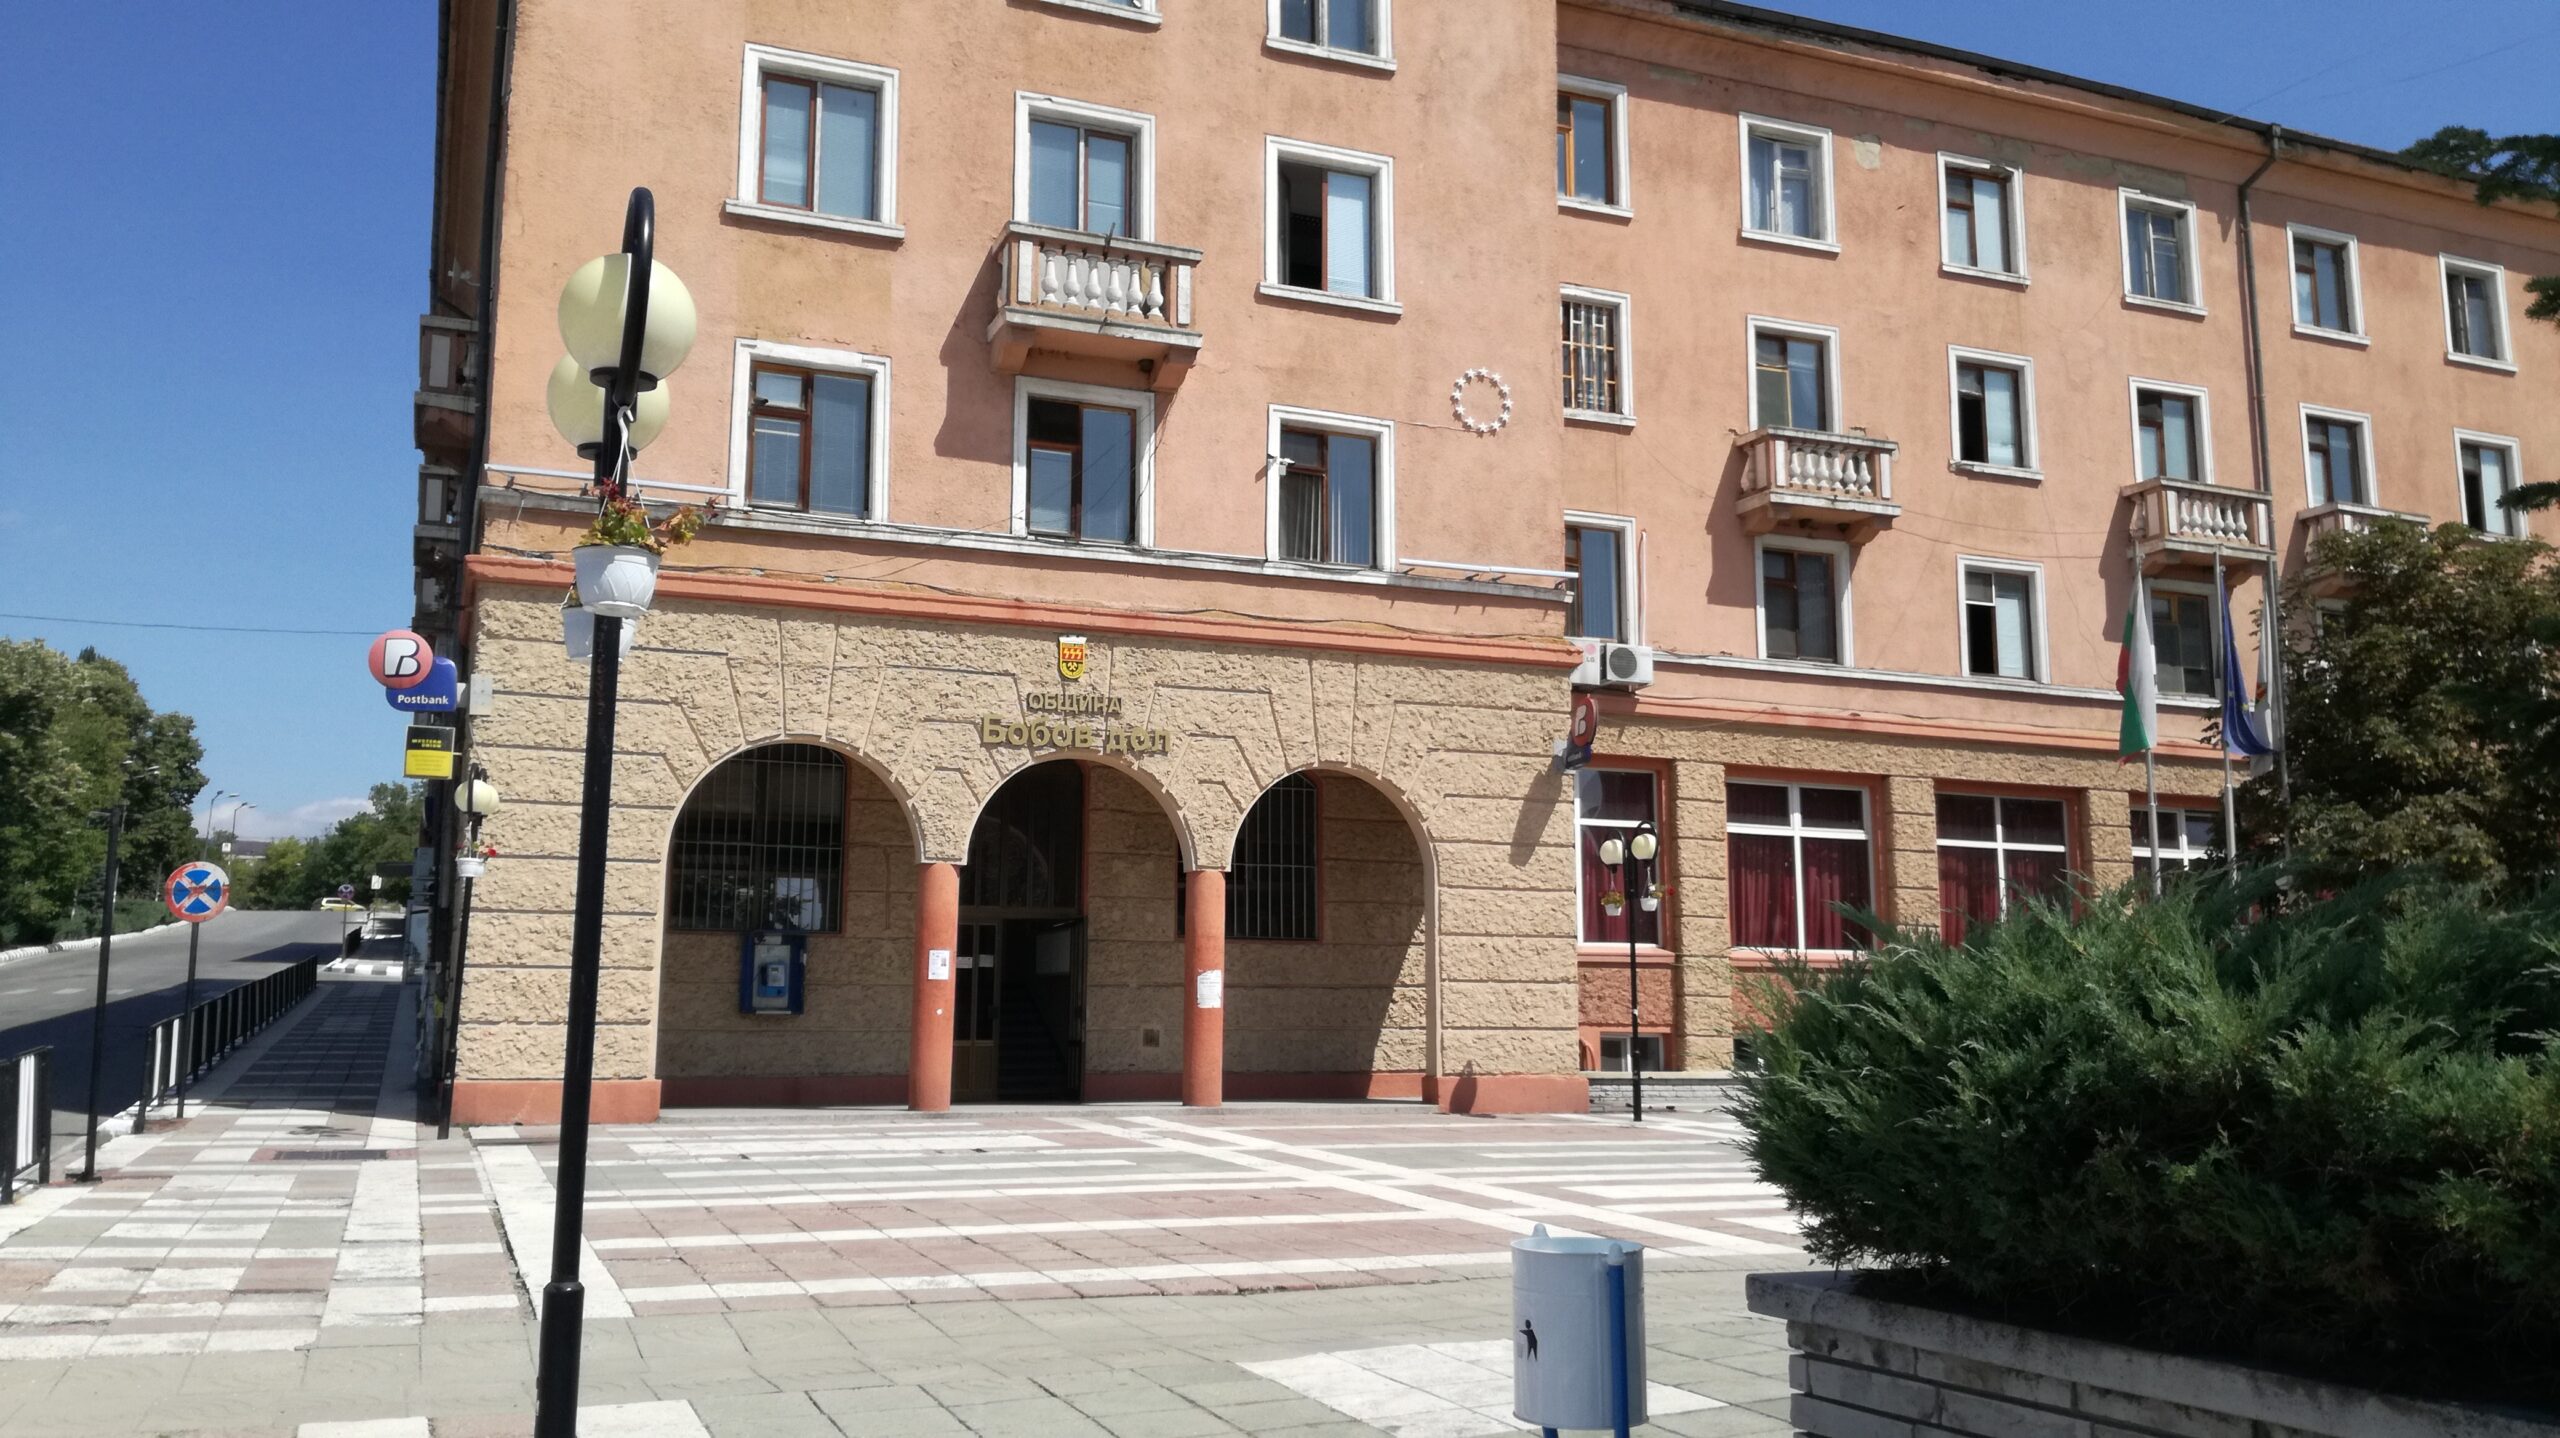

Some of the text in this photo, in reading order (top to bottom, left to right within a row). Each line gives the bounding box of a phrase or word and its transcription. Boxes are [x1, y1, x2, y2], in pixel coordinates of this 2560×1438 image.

[383, 638, 421, 677] B
[397, 695, 449, 705] Postbank
[1028, 693, 1122, 714] ОБЩИНА
[982, 713, 1095, 748] Бобов
